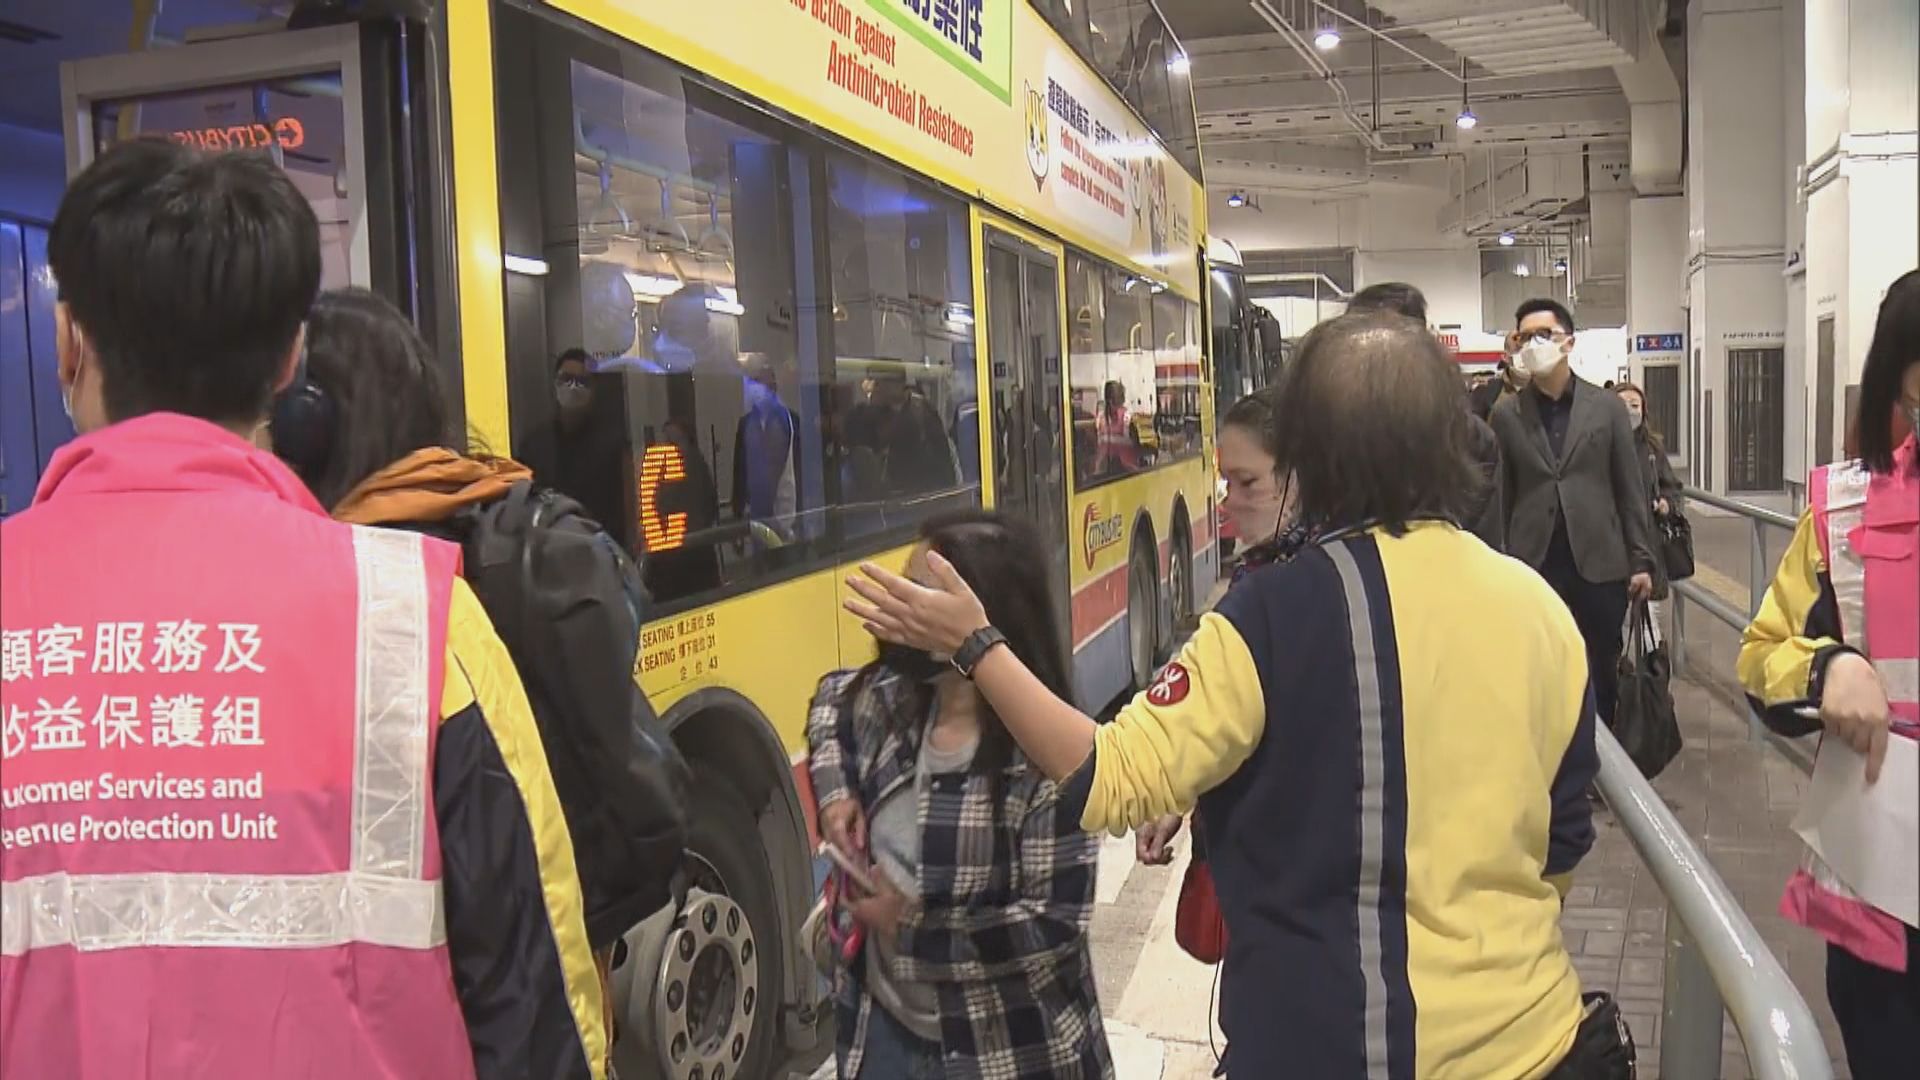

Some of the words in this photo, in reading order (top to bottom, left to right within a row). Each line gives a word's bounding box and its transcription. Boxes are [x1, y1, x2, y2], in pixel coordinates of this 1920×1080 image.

[855, 16, 896, 67] against
[827, 40, 916, 126] Antimicrobial
[918, 94, 974, 158] Resistance
[641, 445, 687, 553] C
[642, 625, 675, 649] SEATING
[706, 612, 715, 627] 55
[644, 648, 676, 672] SEATING
[97, 772, 205, 800] Services
[211, 772, 262, 799] and
[79, 813, 213, 842] Protection
[221, 813, 278, 840] Unit
